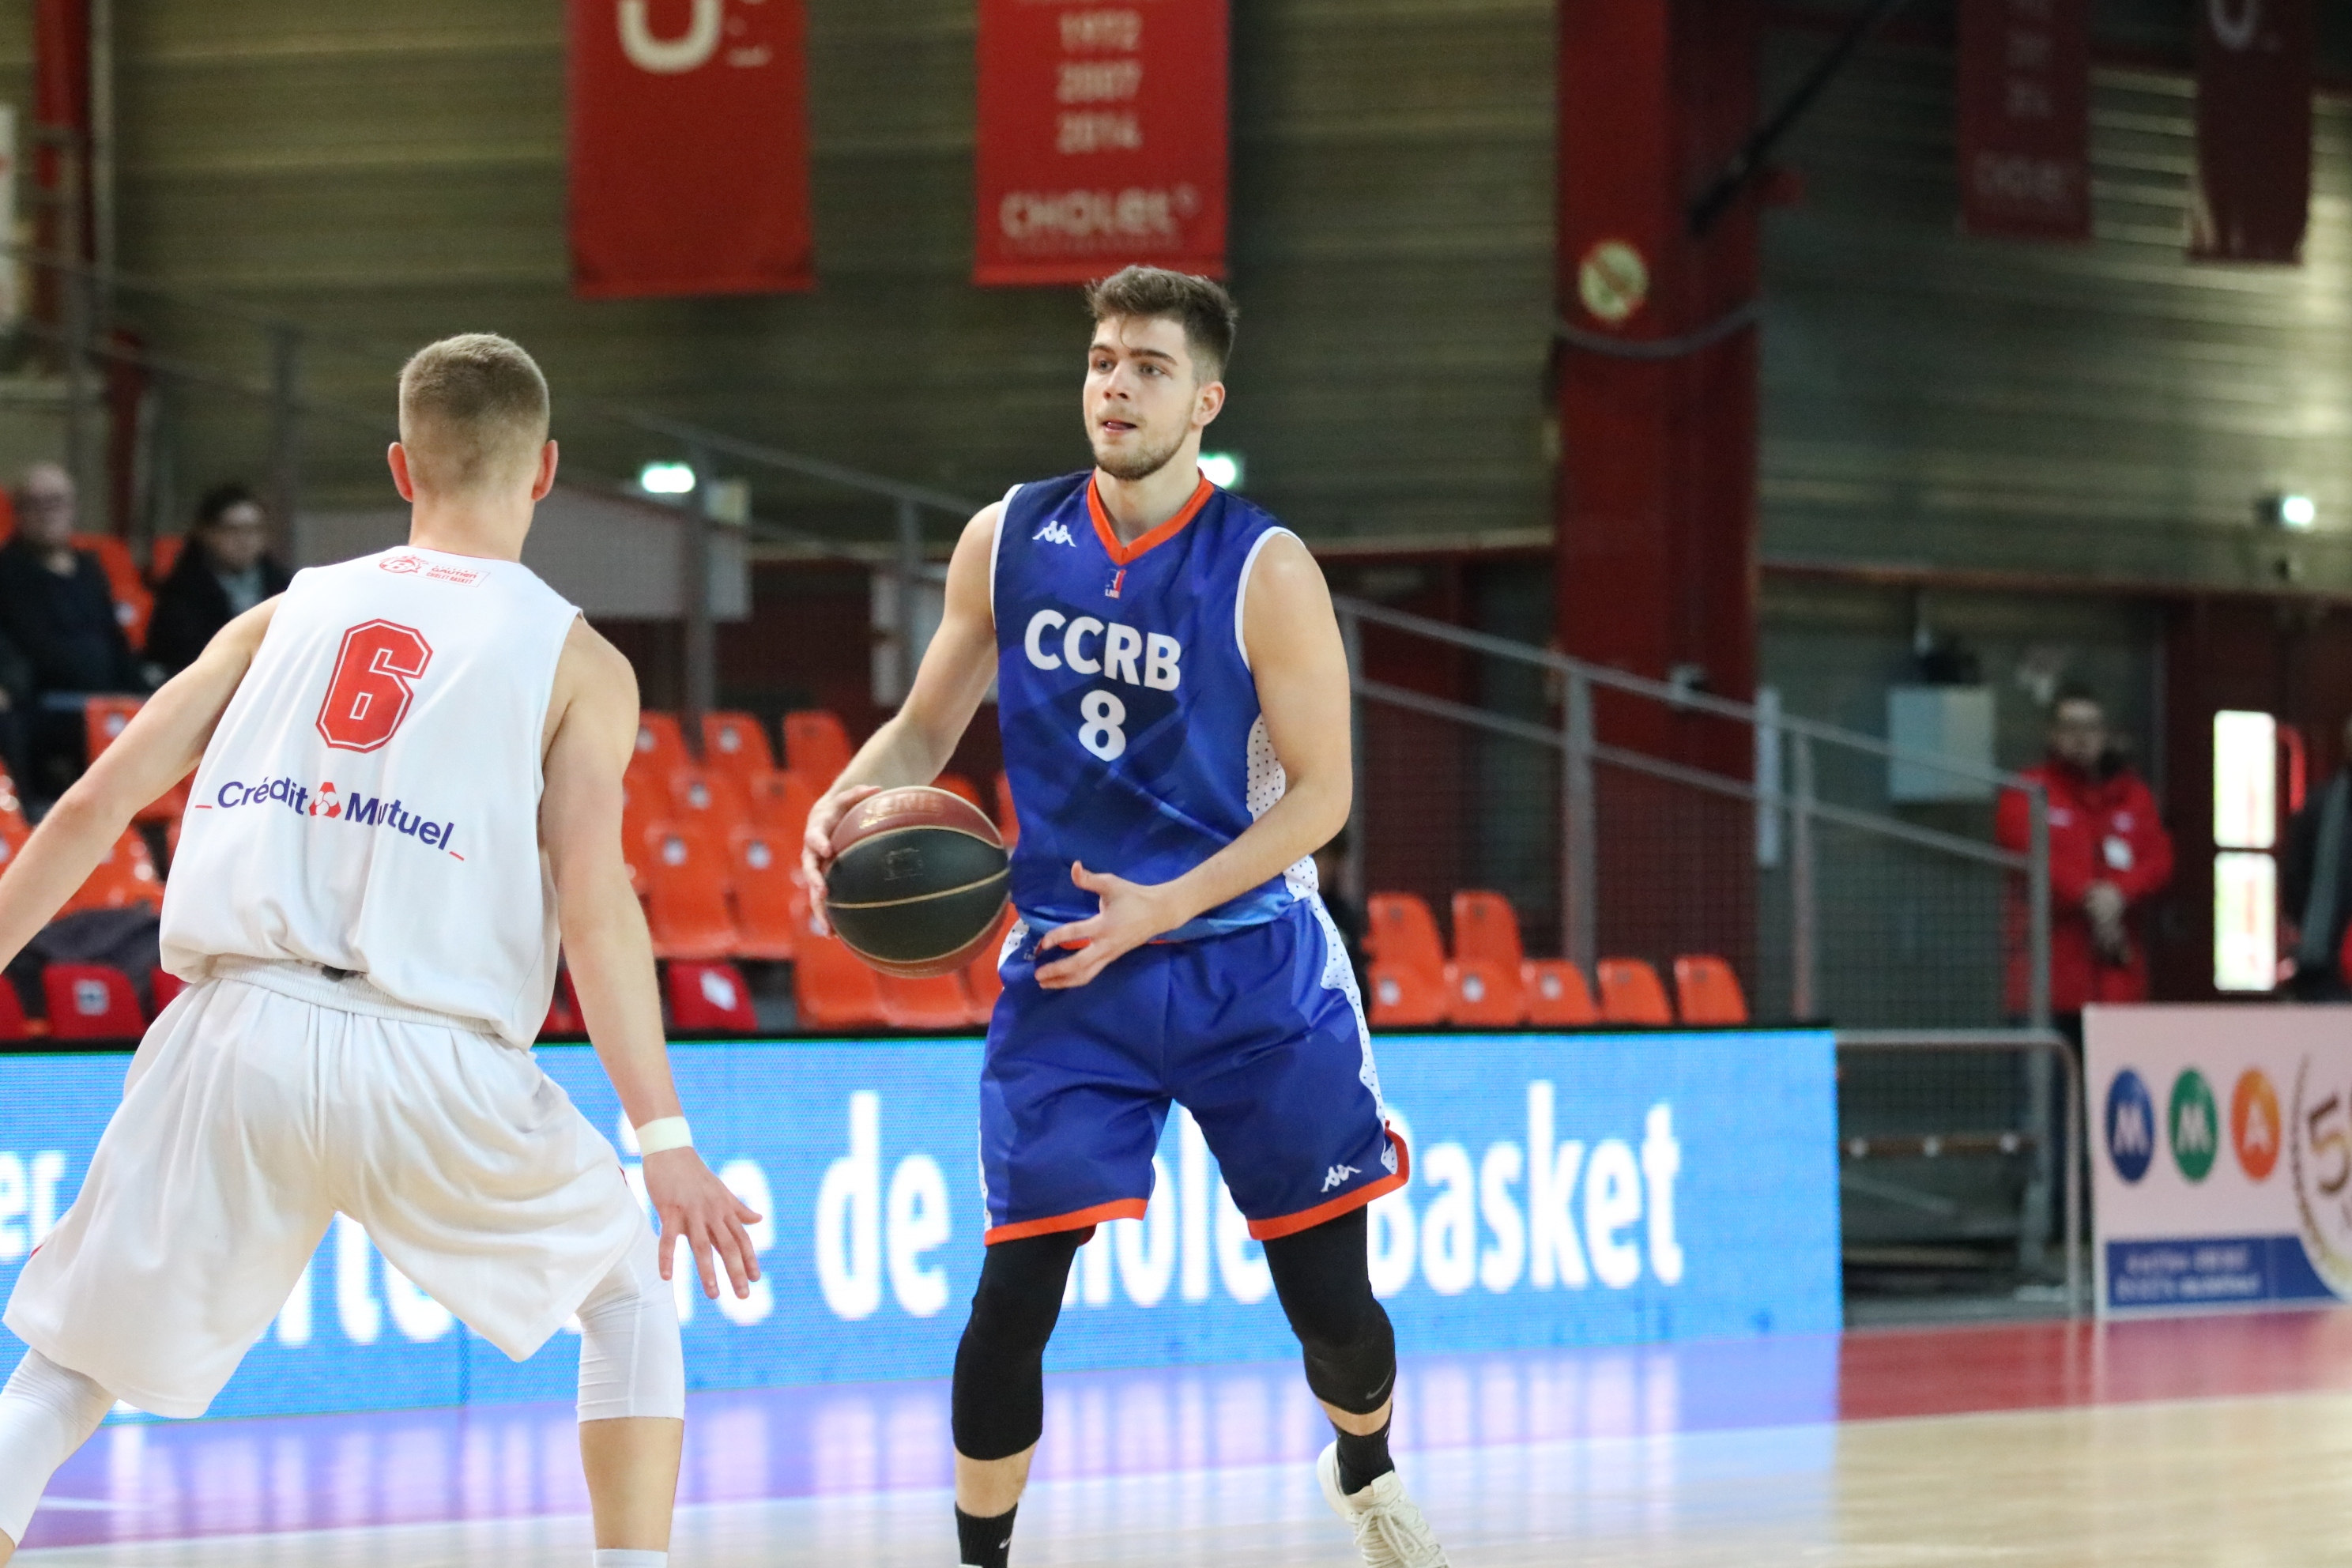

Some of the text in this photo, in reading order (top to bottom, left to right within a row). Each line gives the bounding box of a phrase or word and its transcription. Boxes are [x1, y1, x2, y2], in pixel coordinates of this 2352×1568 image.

[1060, 10, 1140, 51] 1972
[1057, 60, 1141, 102] 2007
[1057, 112, 1141, 153] 2014
[450, 575, 473, 585] BASKET
[315, 618, 433, 754] 6
[1025, 609, 1181, 692] CCRB
[1078, 690, 1127, 762] 8
[217, 776, 454, 851] Crédit Mutuel
[816, 1090, 951, 1321] de
